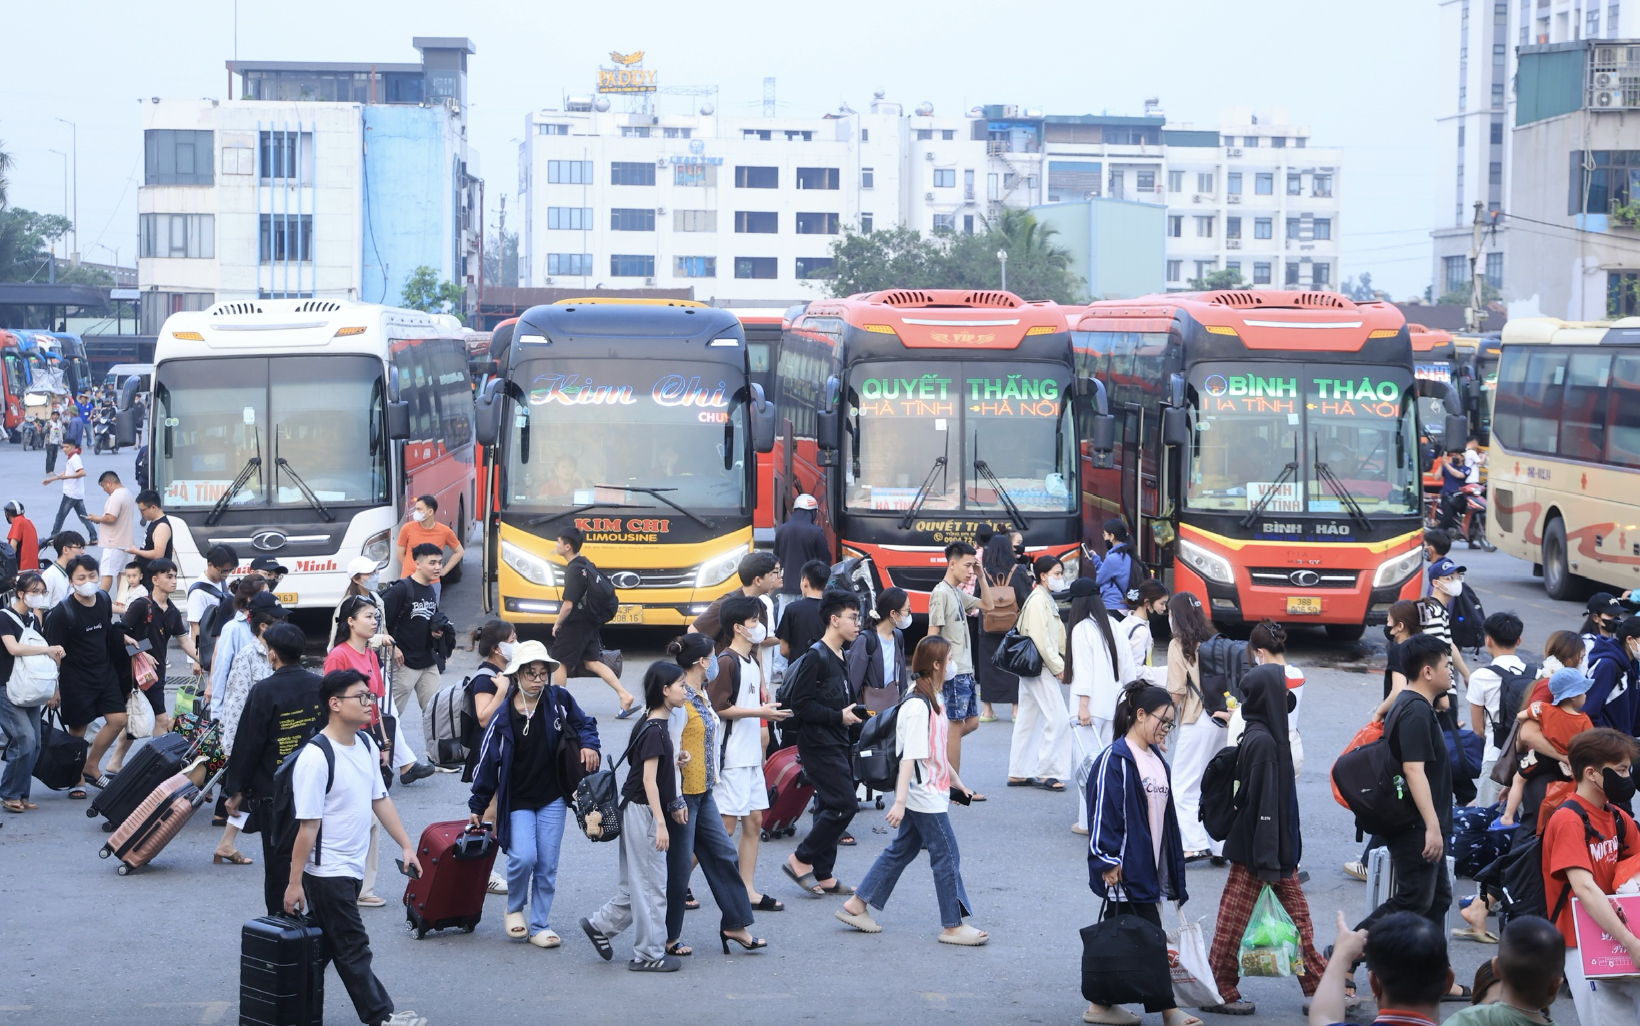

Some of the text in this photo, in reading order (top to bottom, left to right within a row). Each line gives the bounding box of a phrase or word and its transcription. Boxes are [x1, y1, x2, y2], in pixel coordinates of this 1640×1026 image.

[598, 70, 657, 86] PADDY
[953, 334, 975, 342] VIP
[530, 373, 728, 407] Kim Chi
[862, 374, 1059, 400] QUYẾT THẮNG
[1228, 373, 1399, 401] BÌNH THẢO
[863, 400, 953, 416] HÀ TĨNH
[981, 399, 1013, 416] HÀ
[574, 517, 670, 533] KIM CHI
[915, 519, 962, 532] QUYẾT
[1262, 520, 1302, 533] BÌNH
[586, 533, 658, 542] LIMOUSINE
[294, 559, 337, 572] Minh
